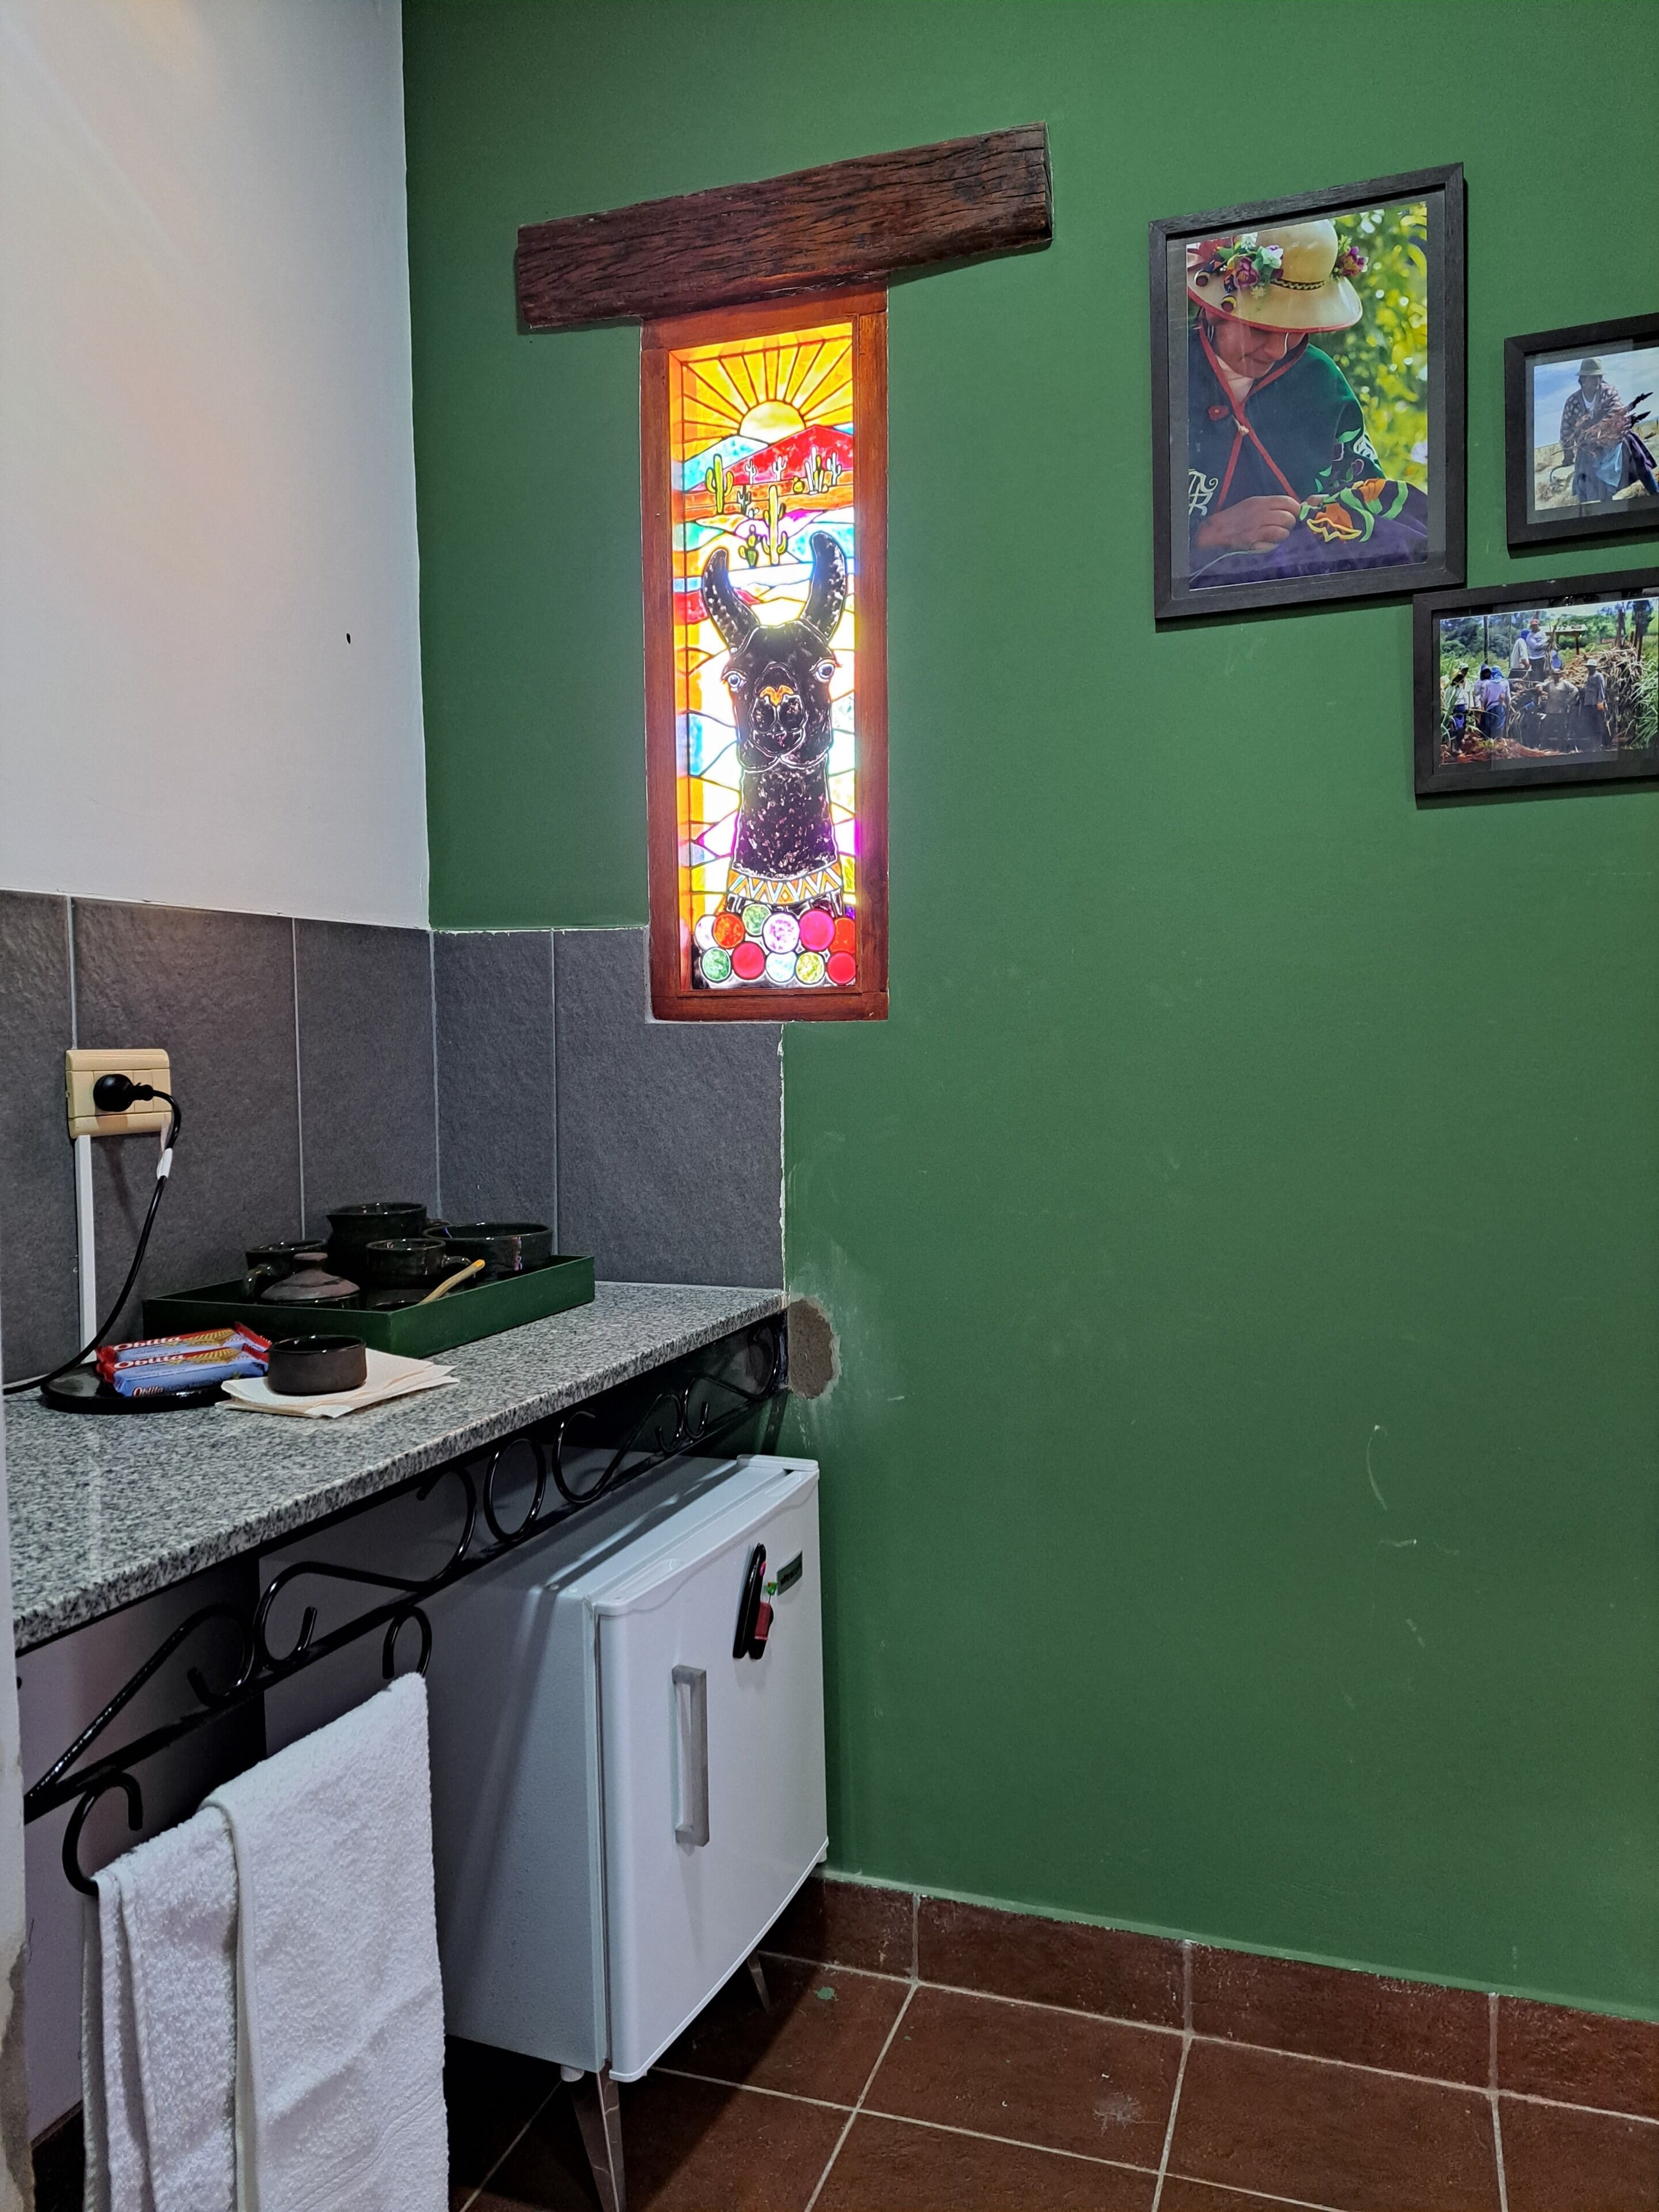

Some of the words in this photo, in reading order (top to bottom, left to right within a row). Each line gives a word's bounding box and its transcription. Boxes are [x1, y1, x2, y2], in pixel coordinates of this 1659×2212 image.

[113, 1336, 181, 1351] Oblita
[113, 1354, 185, 1369] Oblita
[133, 1386, 164, 1396] Oblita
